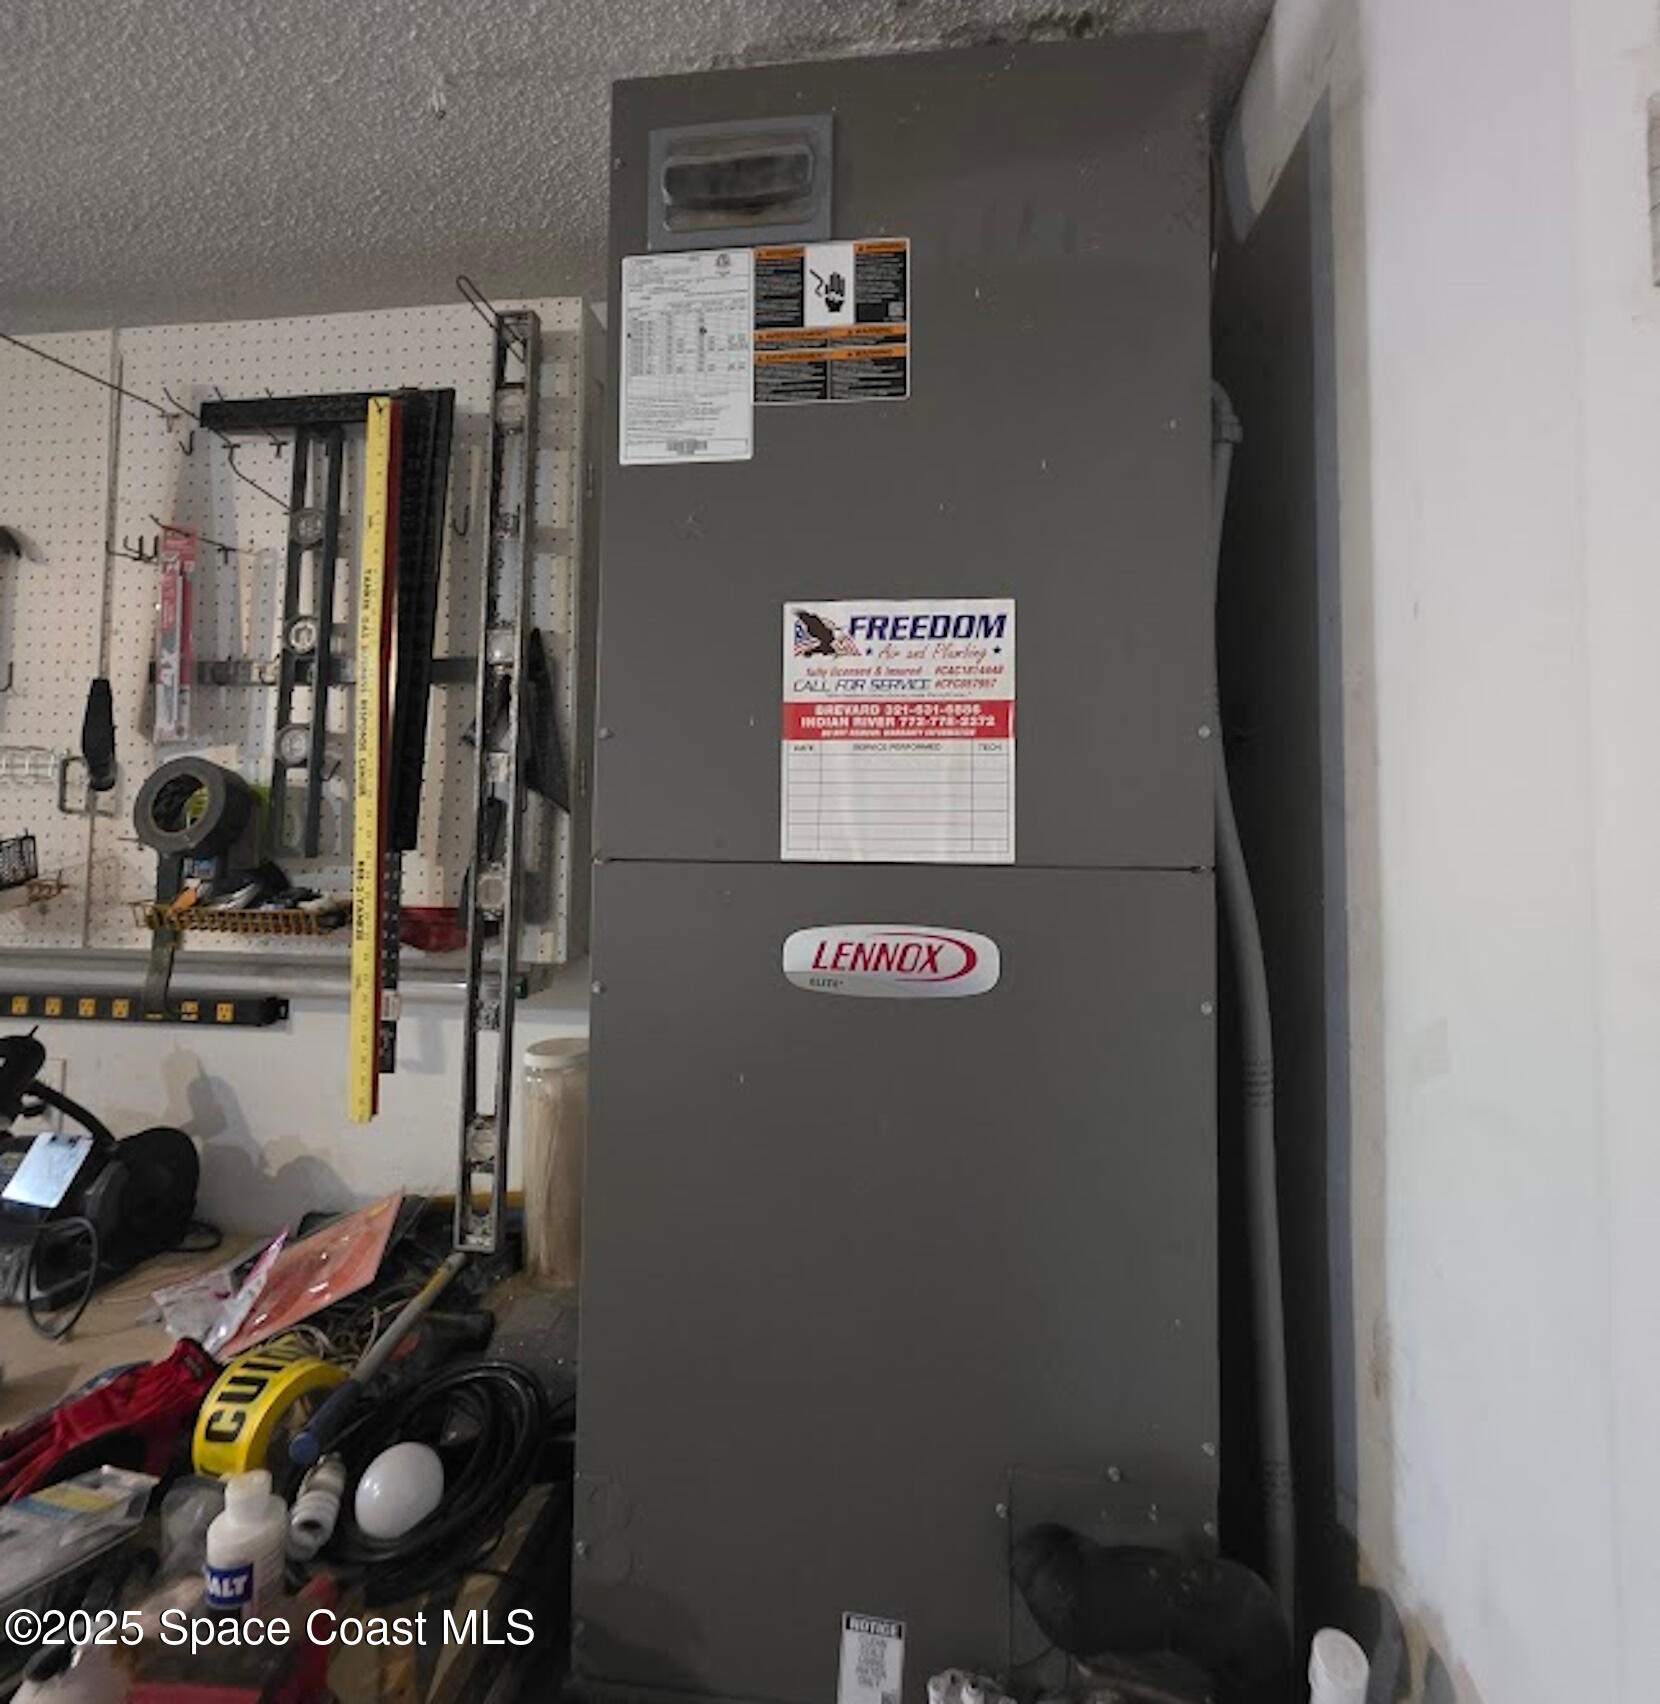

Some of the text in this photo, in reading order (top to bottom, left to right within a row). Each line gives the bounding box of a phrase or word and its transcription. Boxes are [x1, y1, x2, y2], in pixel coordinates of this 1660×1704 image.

[850, 614, 1007, 641] FREEDOM
[793, 679, 830, 692] CALL
[834, 678, 867, 692] FOR
[870, 678, 932, 692] SERVICE
[815, 703, 880, 715] BREVARD
[801, 716, 849, 727] INDIAN
[852, 716, 895, 727] RIVER
[812, 940, 945, 973] LENNOX
